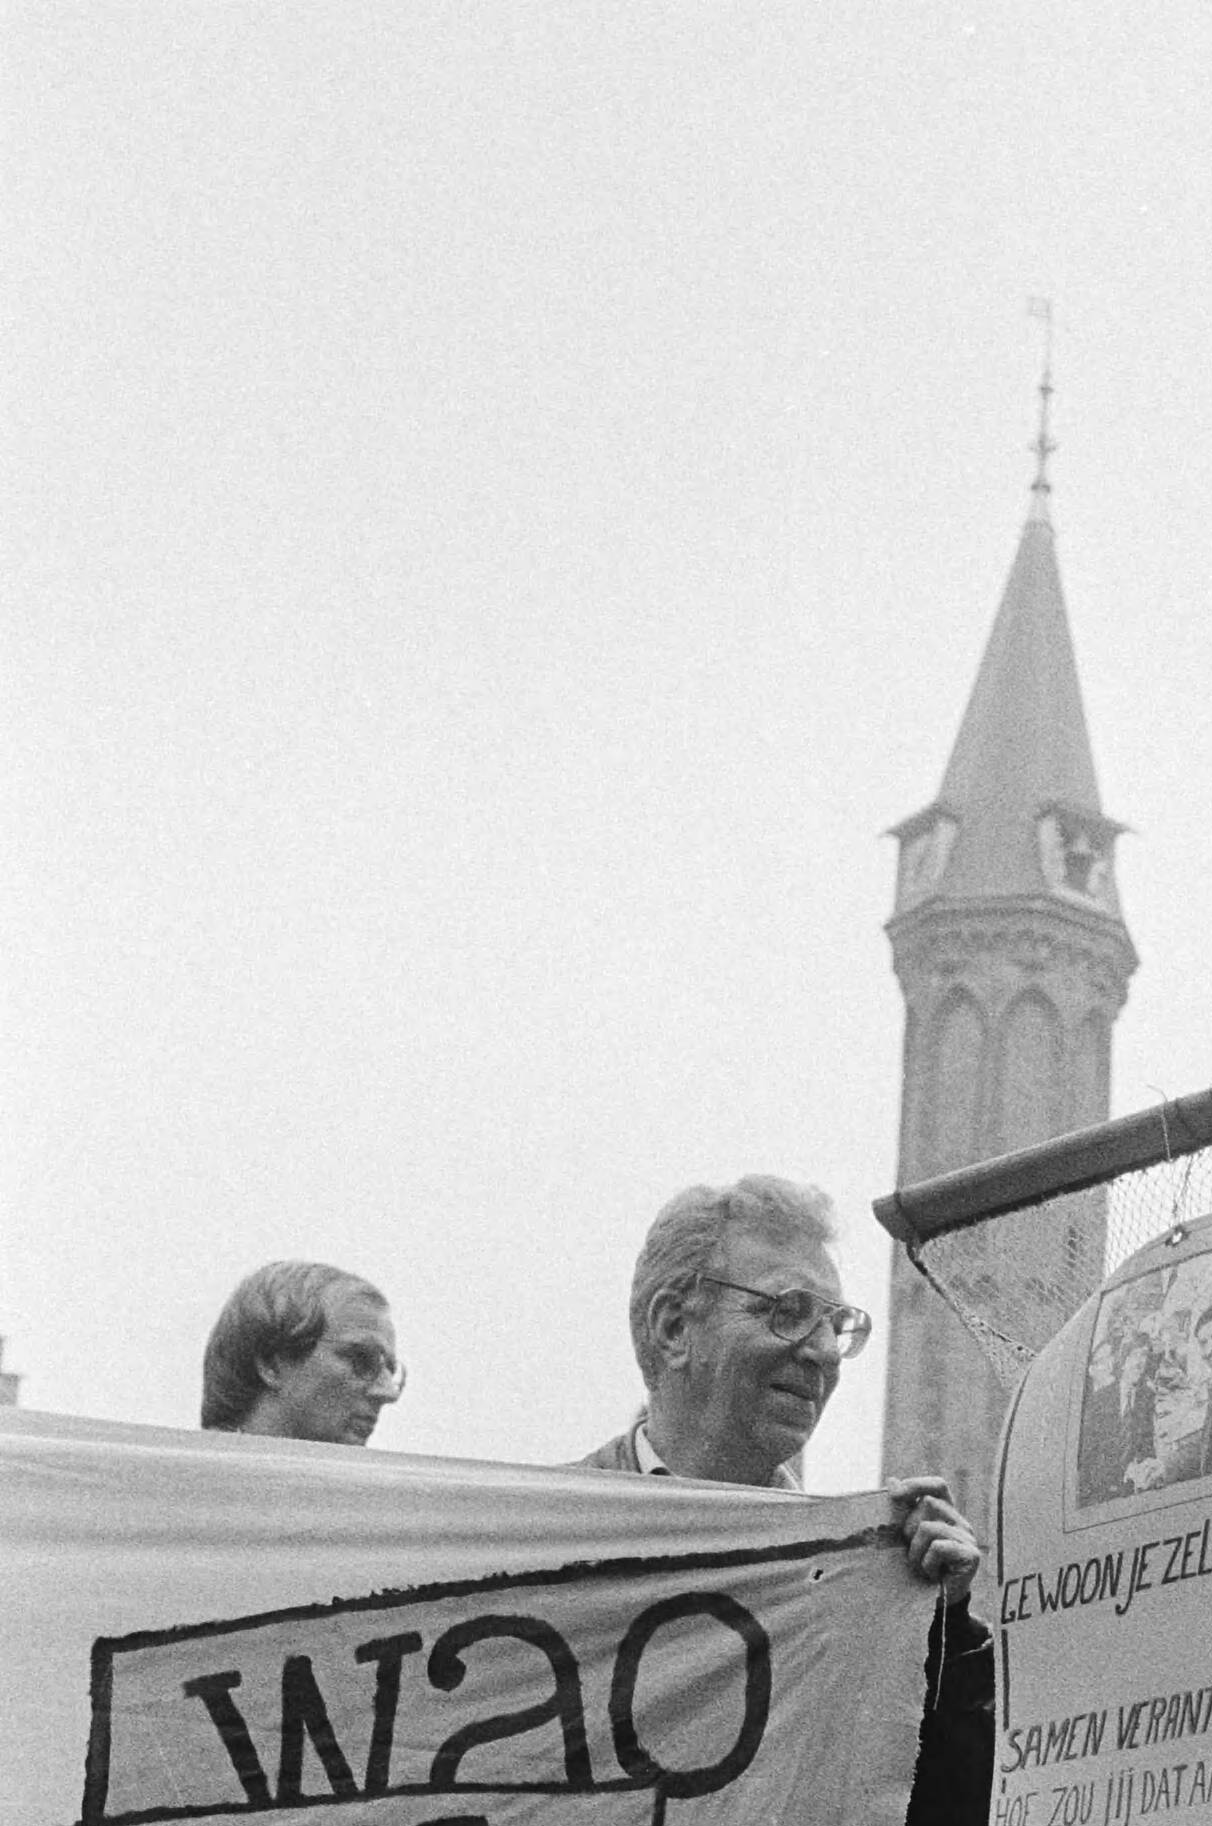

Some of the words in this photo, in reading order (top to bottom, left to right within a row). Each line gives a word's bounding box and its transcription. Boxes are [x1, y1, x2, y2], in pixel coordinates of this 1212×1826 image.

[1001, 1552, 1124, 1624] GEWOON
[1116, 1542, 1161, 1615] JE
[1001, 1709, 1107, 1773] SAMEN
[1141, 1764, 1188, 1815] DAT
